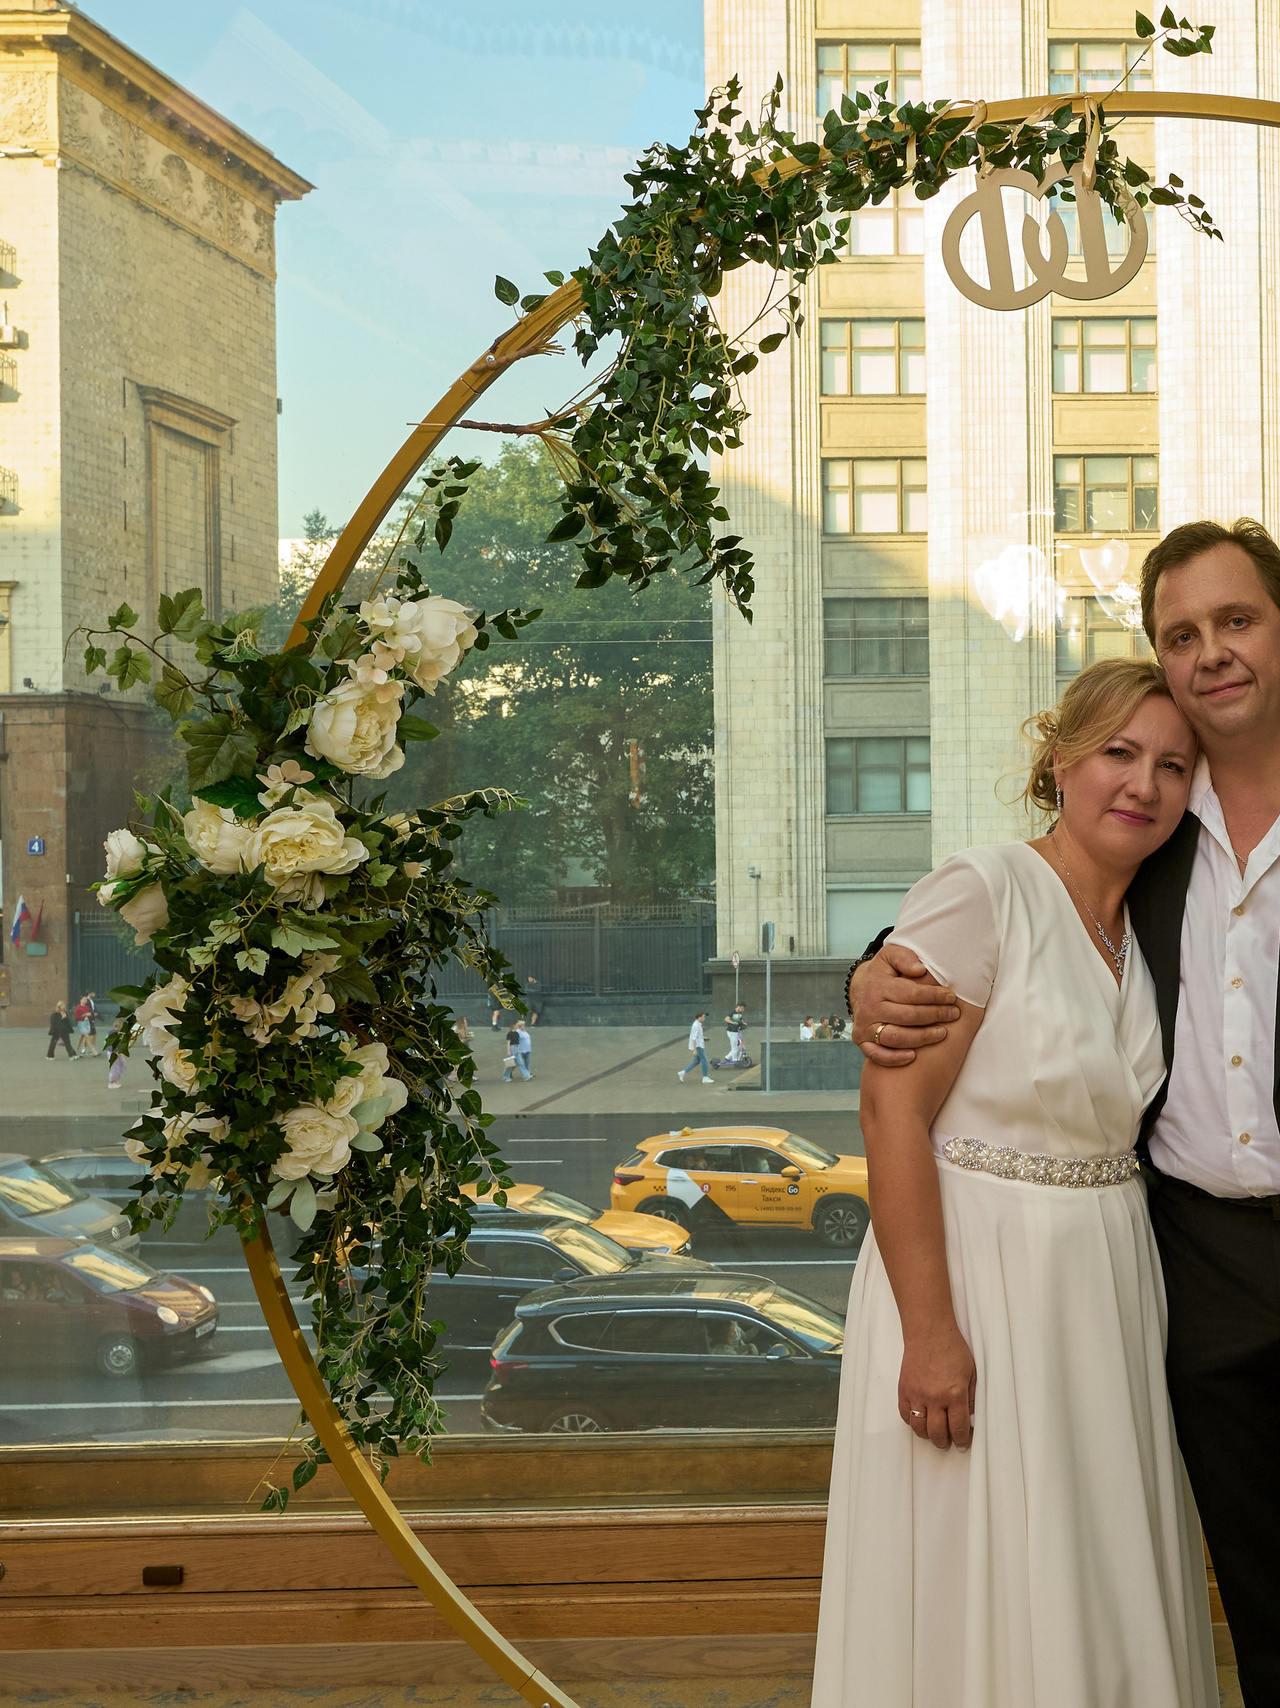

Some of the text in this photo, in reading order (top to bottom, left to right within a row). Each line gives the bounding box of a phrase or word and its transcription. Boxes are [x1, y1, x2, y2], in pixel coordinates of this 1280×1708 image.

[31, 841, 39, 852] 4
[703, 1184, 709, 1192] Я
[760, 1185, 799, 1194] Яндекс Go
